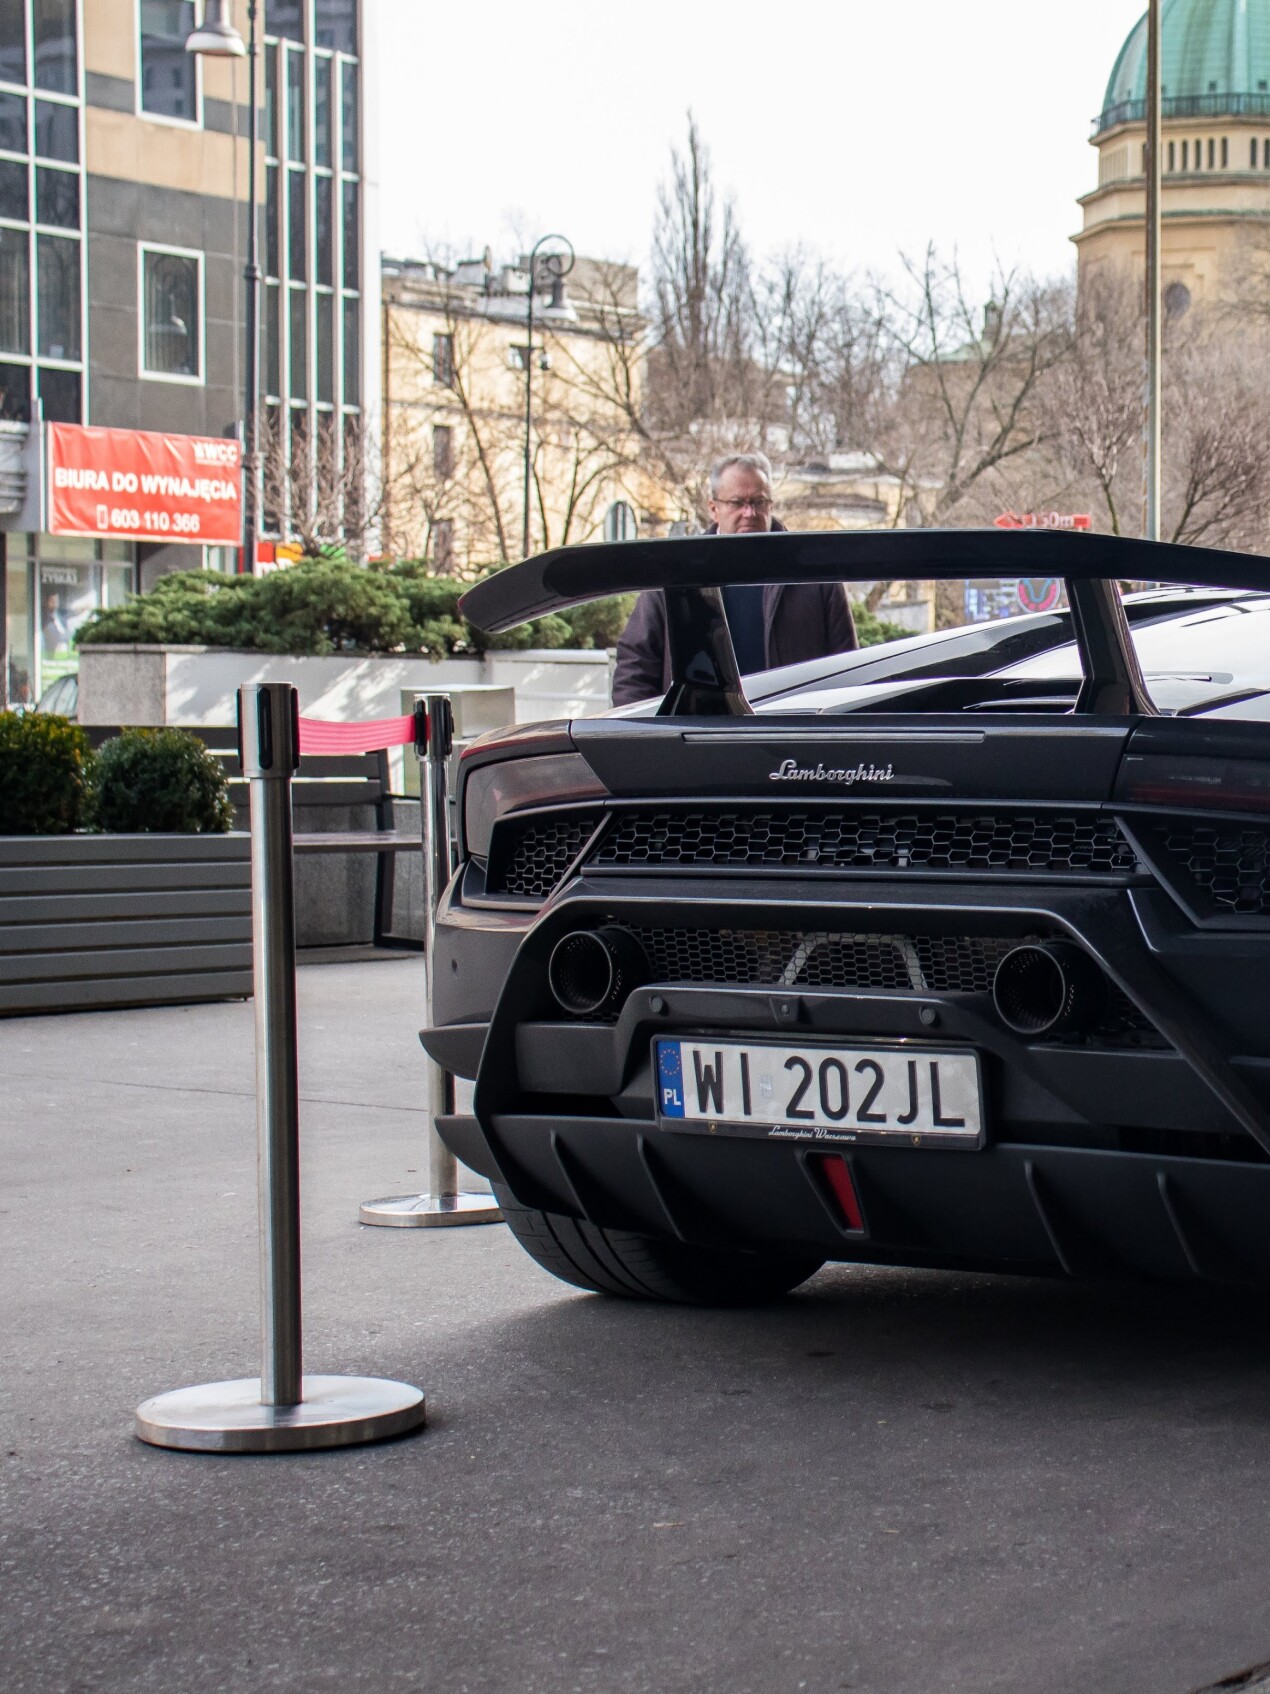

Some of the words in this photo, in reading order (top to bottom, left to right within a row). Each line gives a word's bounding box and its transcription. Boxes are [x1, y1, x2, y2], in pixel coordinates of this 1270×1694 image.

[55, 467, 109, 491] BIURA
[112, 472, 139, 493] DO
[140, 474, 237, 502] WYNAJĘCIA
[111, 508, 140, 529] 603
[143, 511, 170, 532] 110
[769, 759, 894, 785] Lamborghini
[664, 1088, 682, 1106] PL
[693, 1049, 752, 1116] WI
[784, 1055, 966, 1127] 202JL
[768, 1125, 813, 1140] Lamborghini
[814, 1127, 856, 1141] Warszawa
